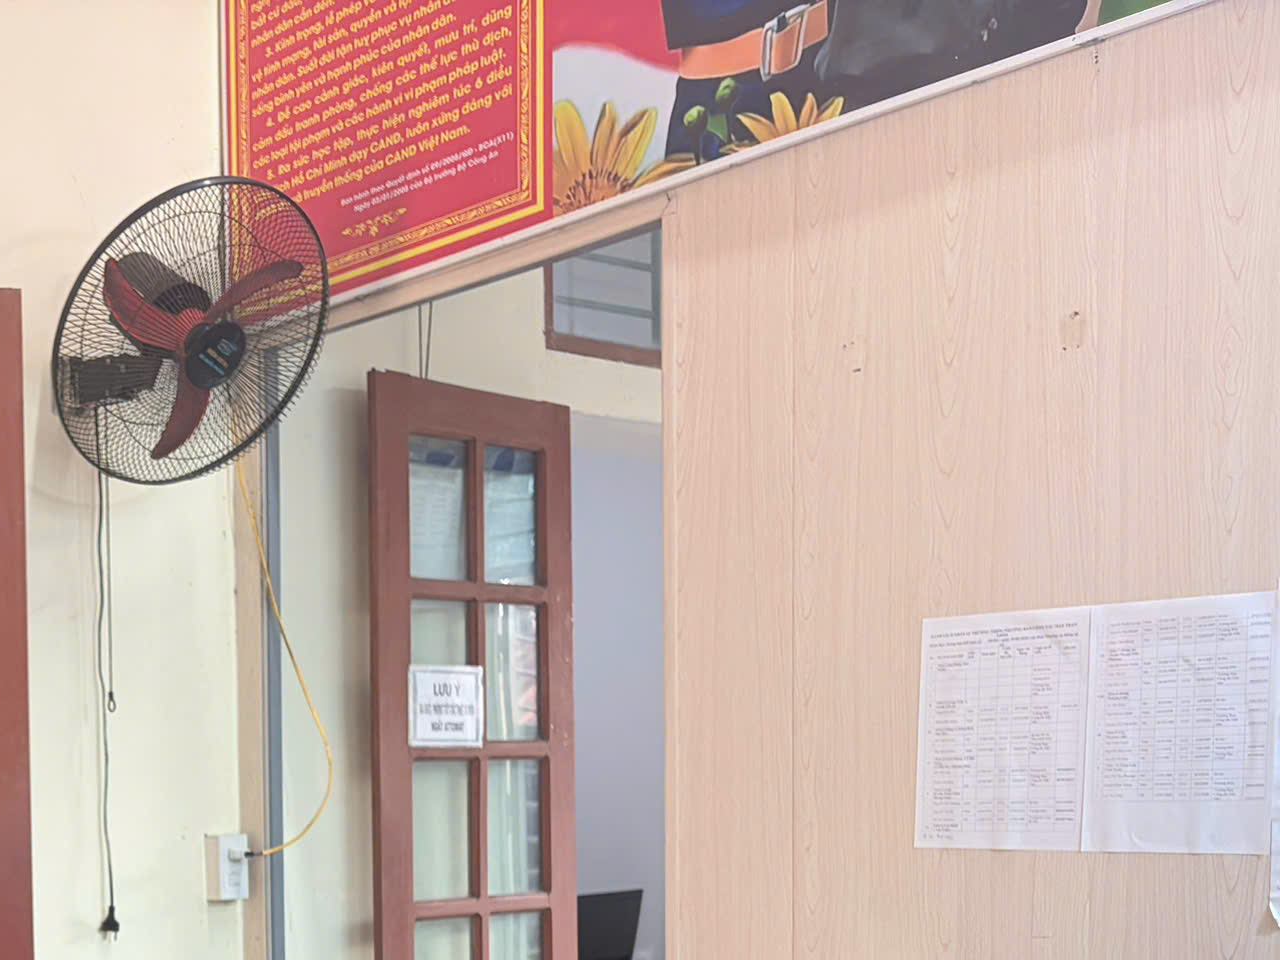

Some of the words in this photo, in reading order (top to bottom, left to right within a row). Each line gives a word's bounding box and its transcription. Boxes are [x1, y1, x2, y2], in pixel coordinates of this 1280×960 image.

[370, 132, 404, 153] CAND,
[386, 145, 416, 165] CAND
[418, 135, 439, 152] Việt
[441, 126, 470, 143] Nam.
